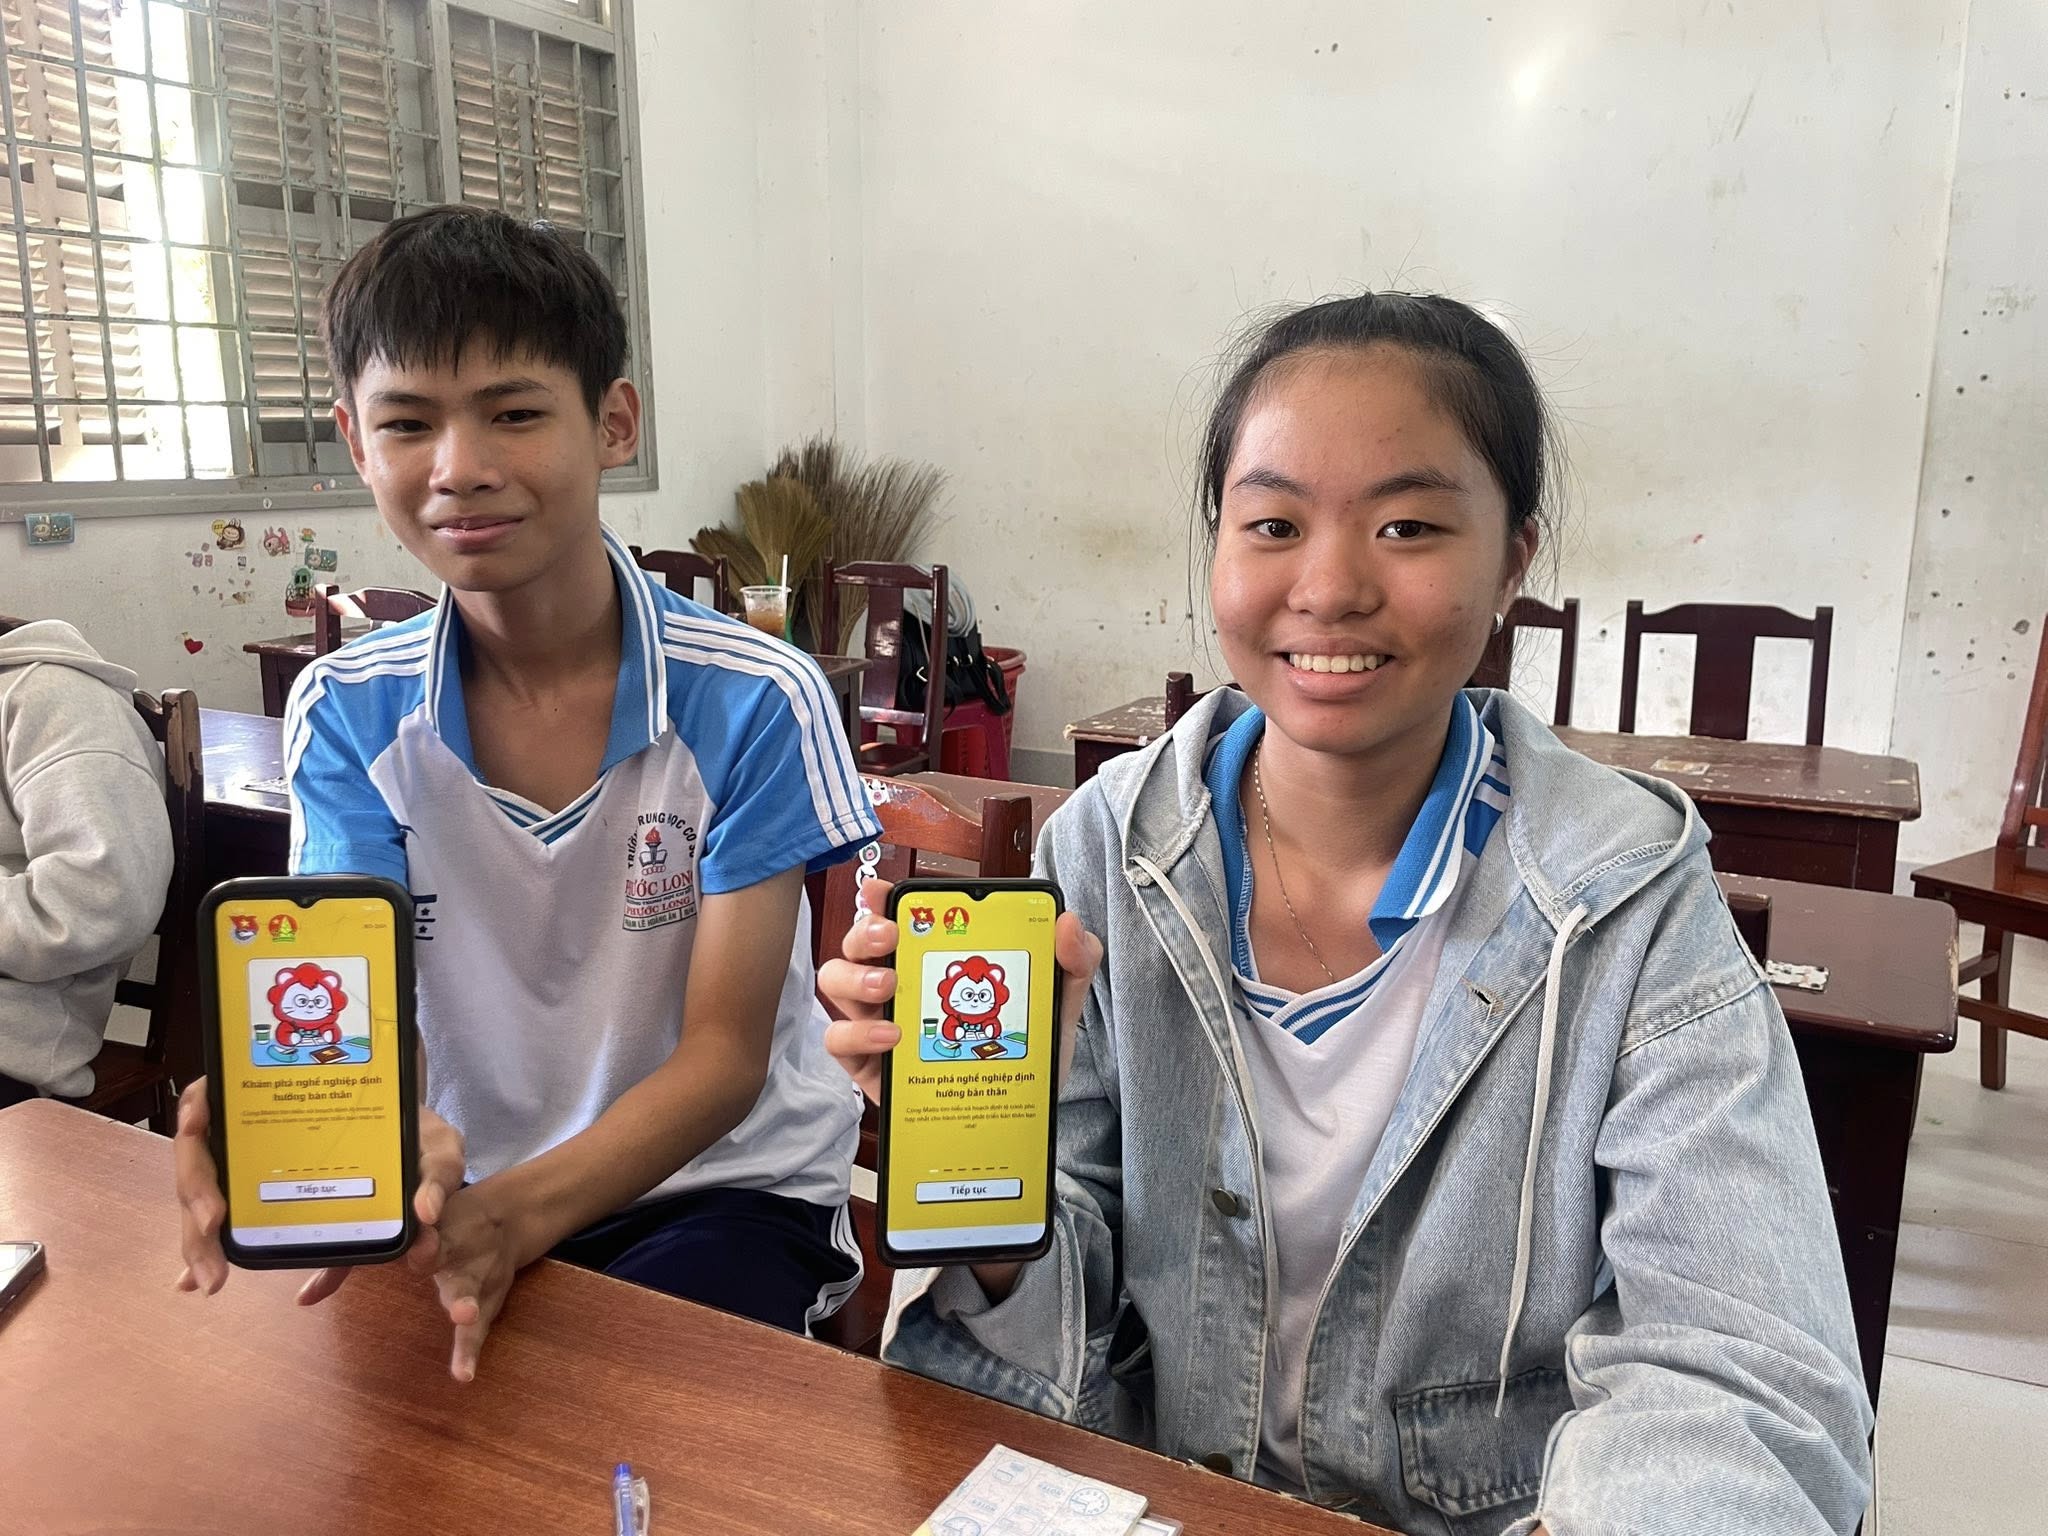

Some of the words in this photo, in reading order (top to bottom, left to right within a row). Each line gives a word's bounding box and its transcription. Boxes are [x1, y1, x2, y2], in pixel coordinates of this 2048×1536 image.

[637, 812, 666, 826] RUNG
[662, 869, 693, 892] LON
[908, 1075, 936, 1085] Khám
[937, 1074, 955, 1086] phá
[981, 1072, 1013, 1084] nghiệp
[1014, 1072, 1036, 1083] định
[935, 1088, 965, 1099] hướng
[986, 1087, 1008, 1096] thân
[950, 1184, 971, 1196] Tiếp
[972, 1186, 988, 1195] tục
